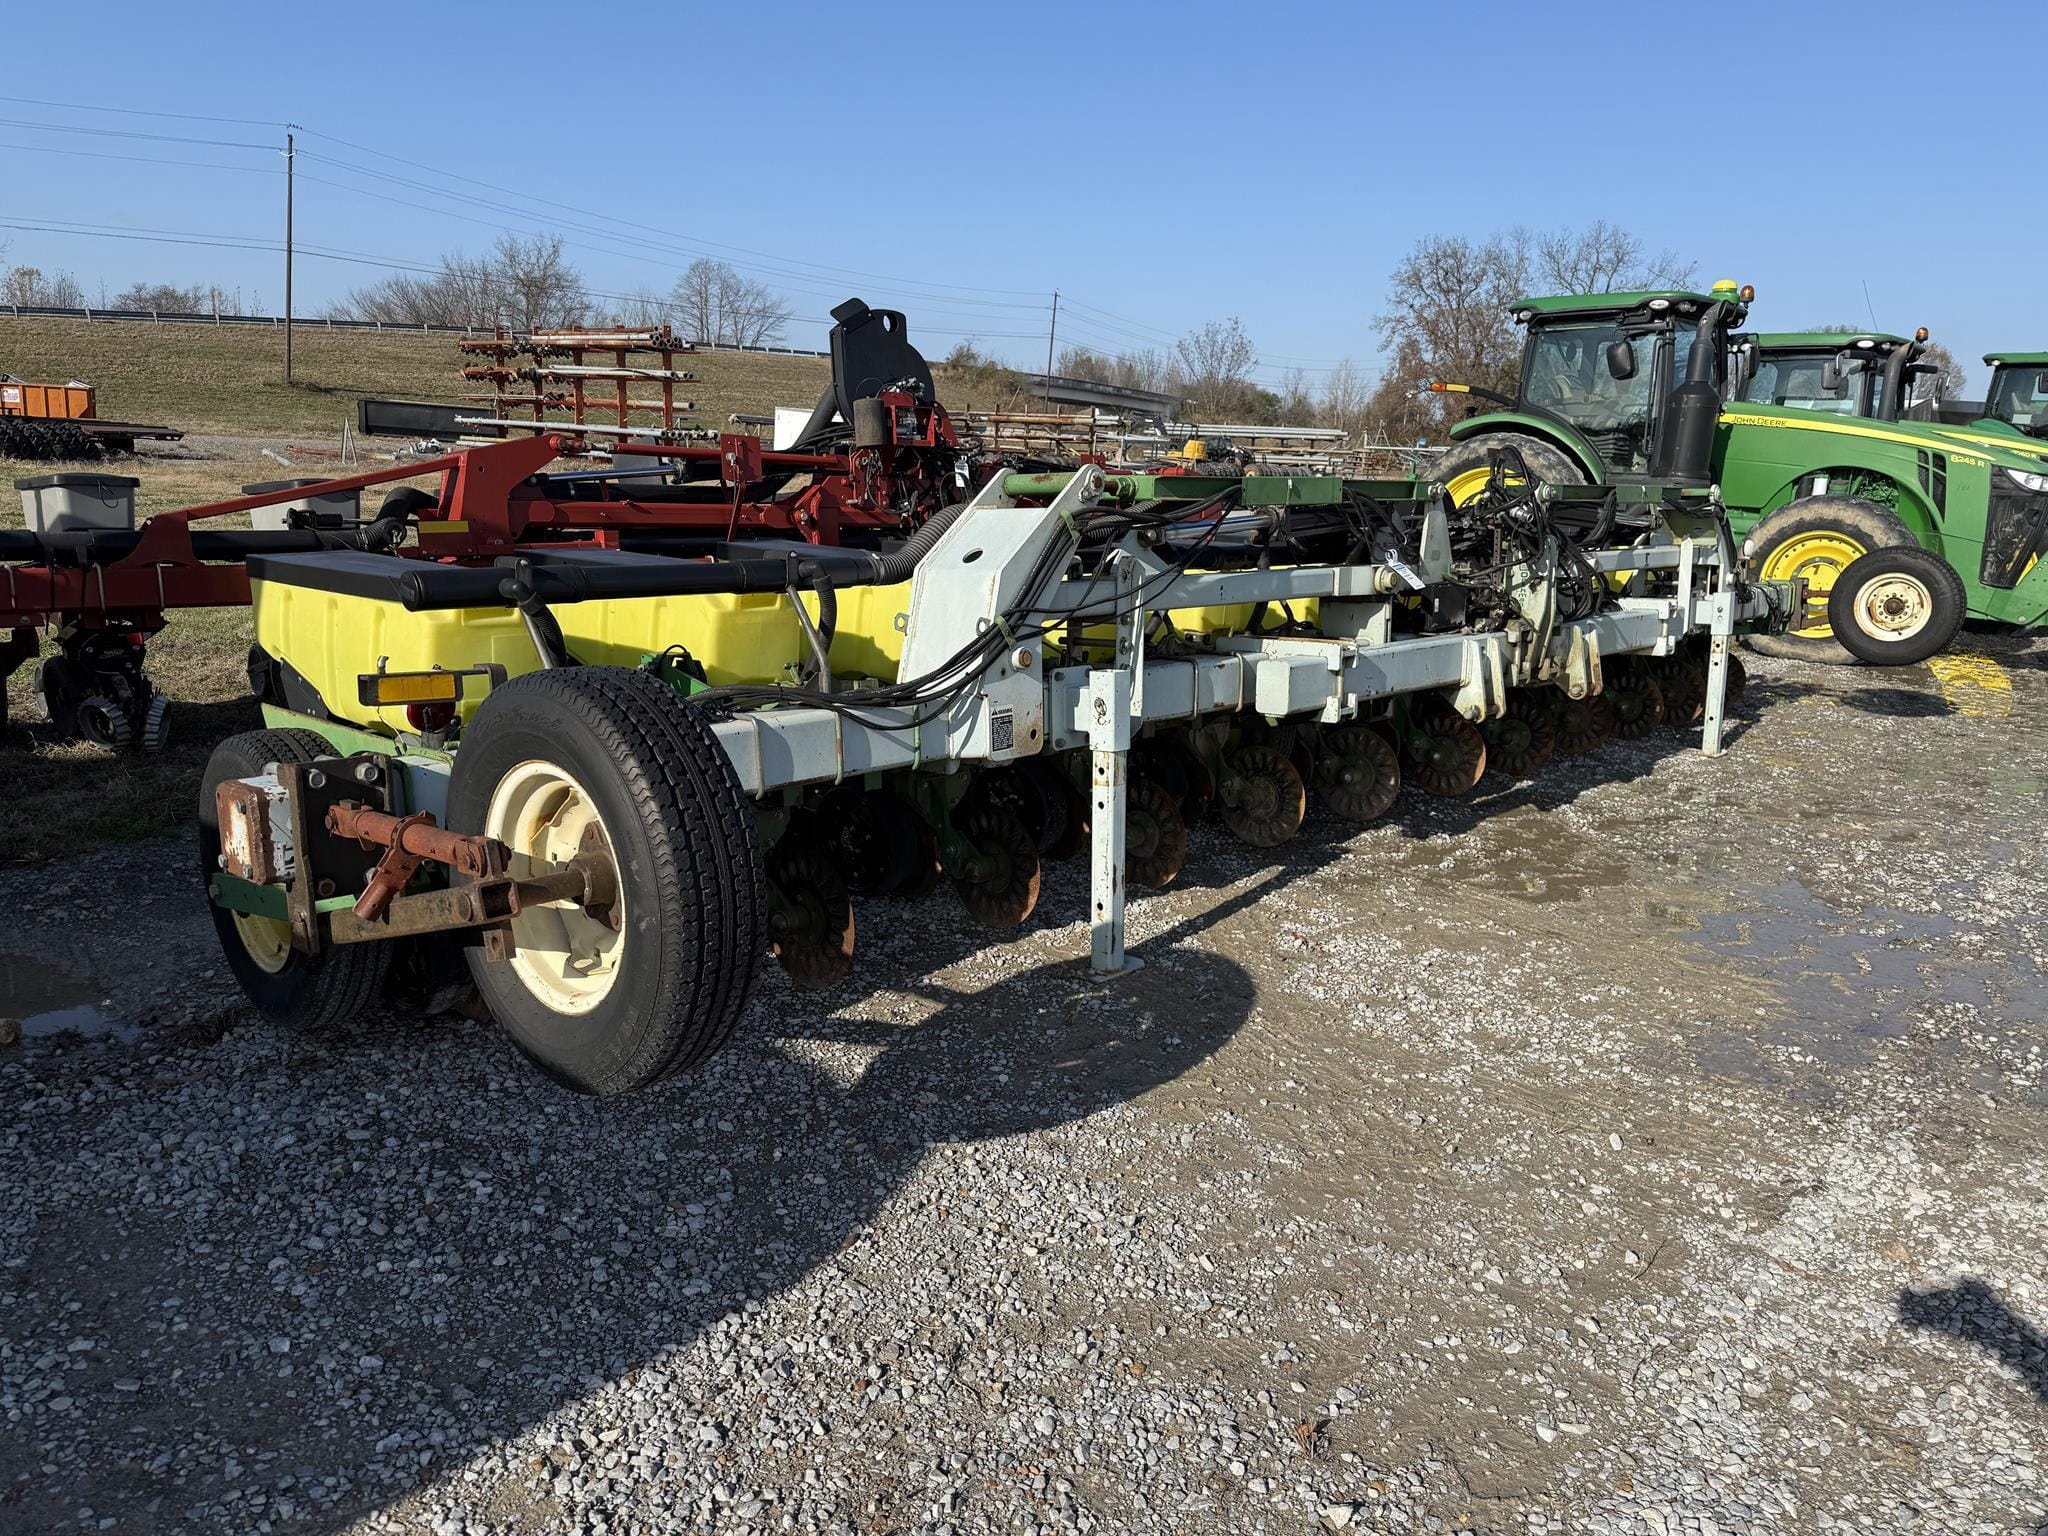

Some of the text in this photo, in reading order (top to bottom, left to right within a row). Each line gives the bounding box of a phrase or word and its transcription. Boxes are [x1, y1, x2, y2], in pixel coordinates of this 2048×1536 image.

[1731, 415, 1788, 427] JOHN DEERE
[1977, 460, 1985, 468] R
